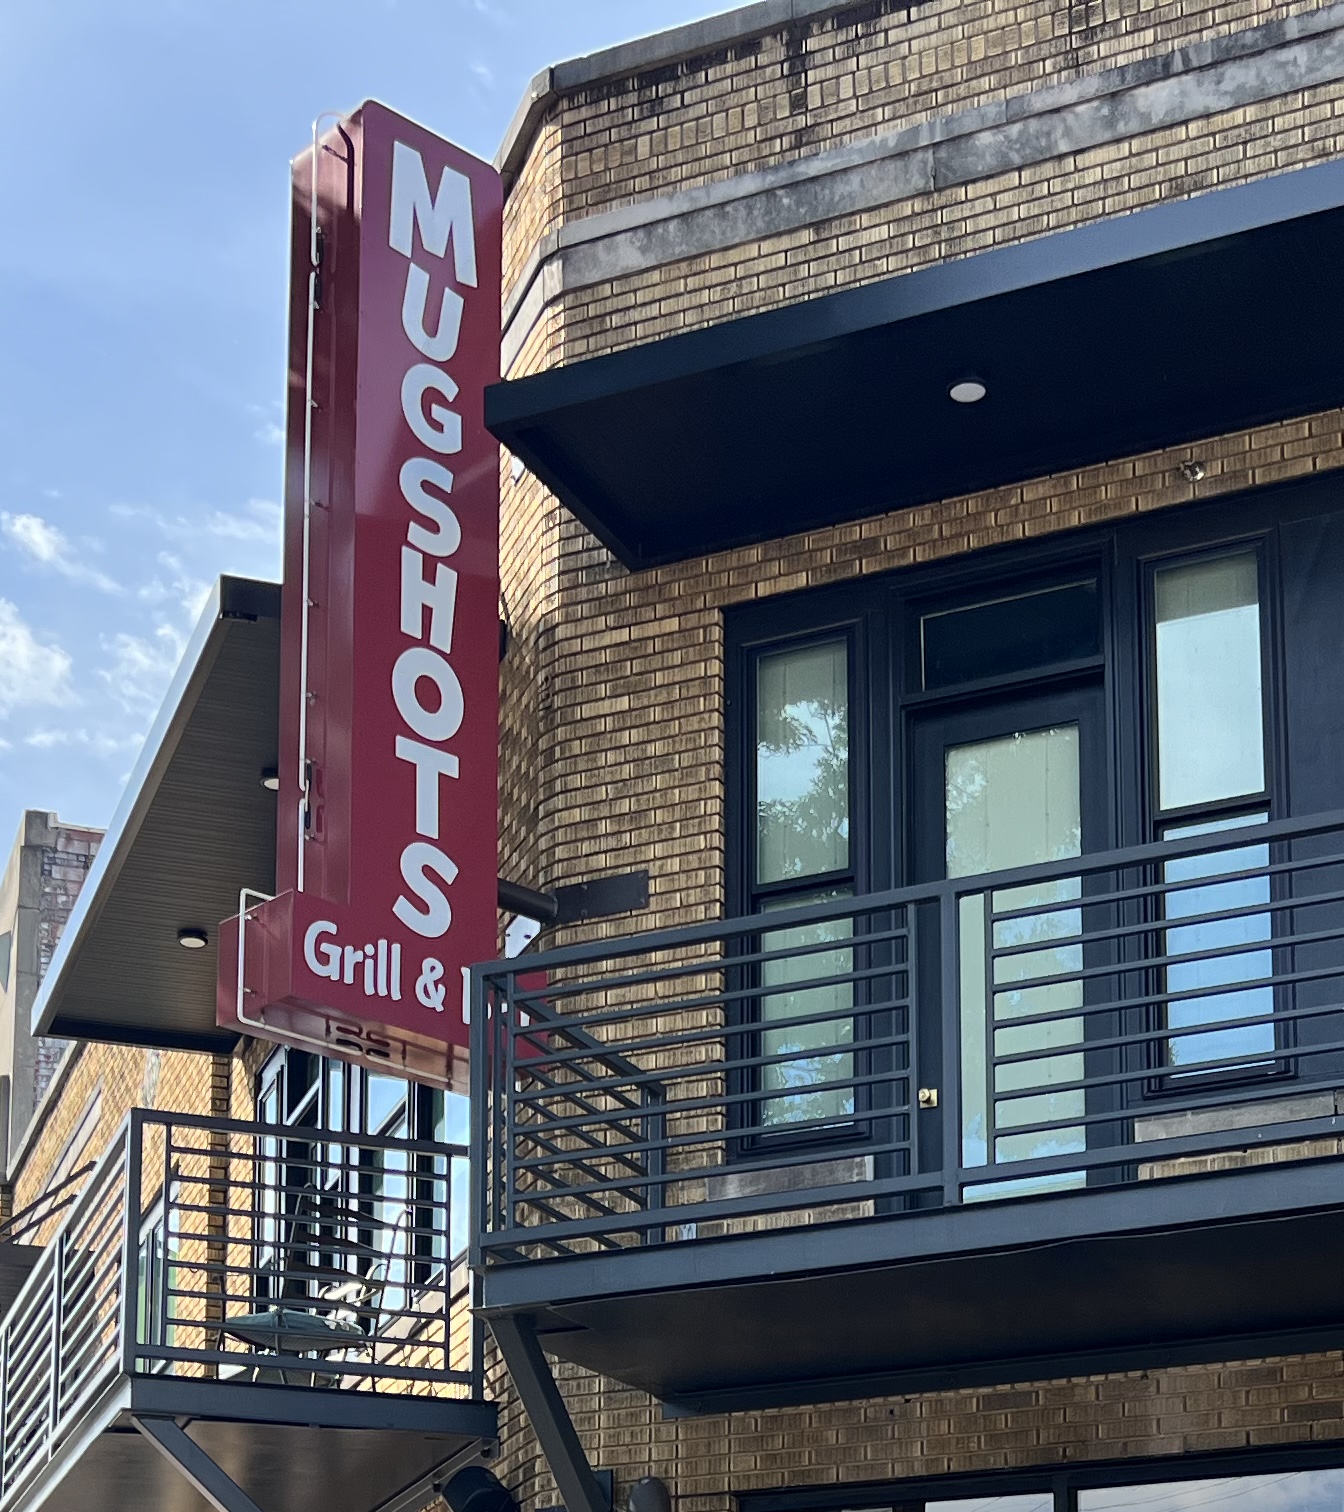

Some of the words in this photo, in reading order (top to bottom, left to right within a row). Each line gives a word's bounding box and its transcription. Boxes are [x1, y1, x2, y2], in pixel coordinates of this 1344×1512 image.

[389, 140, 478, 938] MUGSHOTS
[304, 920, 402, 1001] Grill
[414, 957, 446, 1012] &
